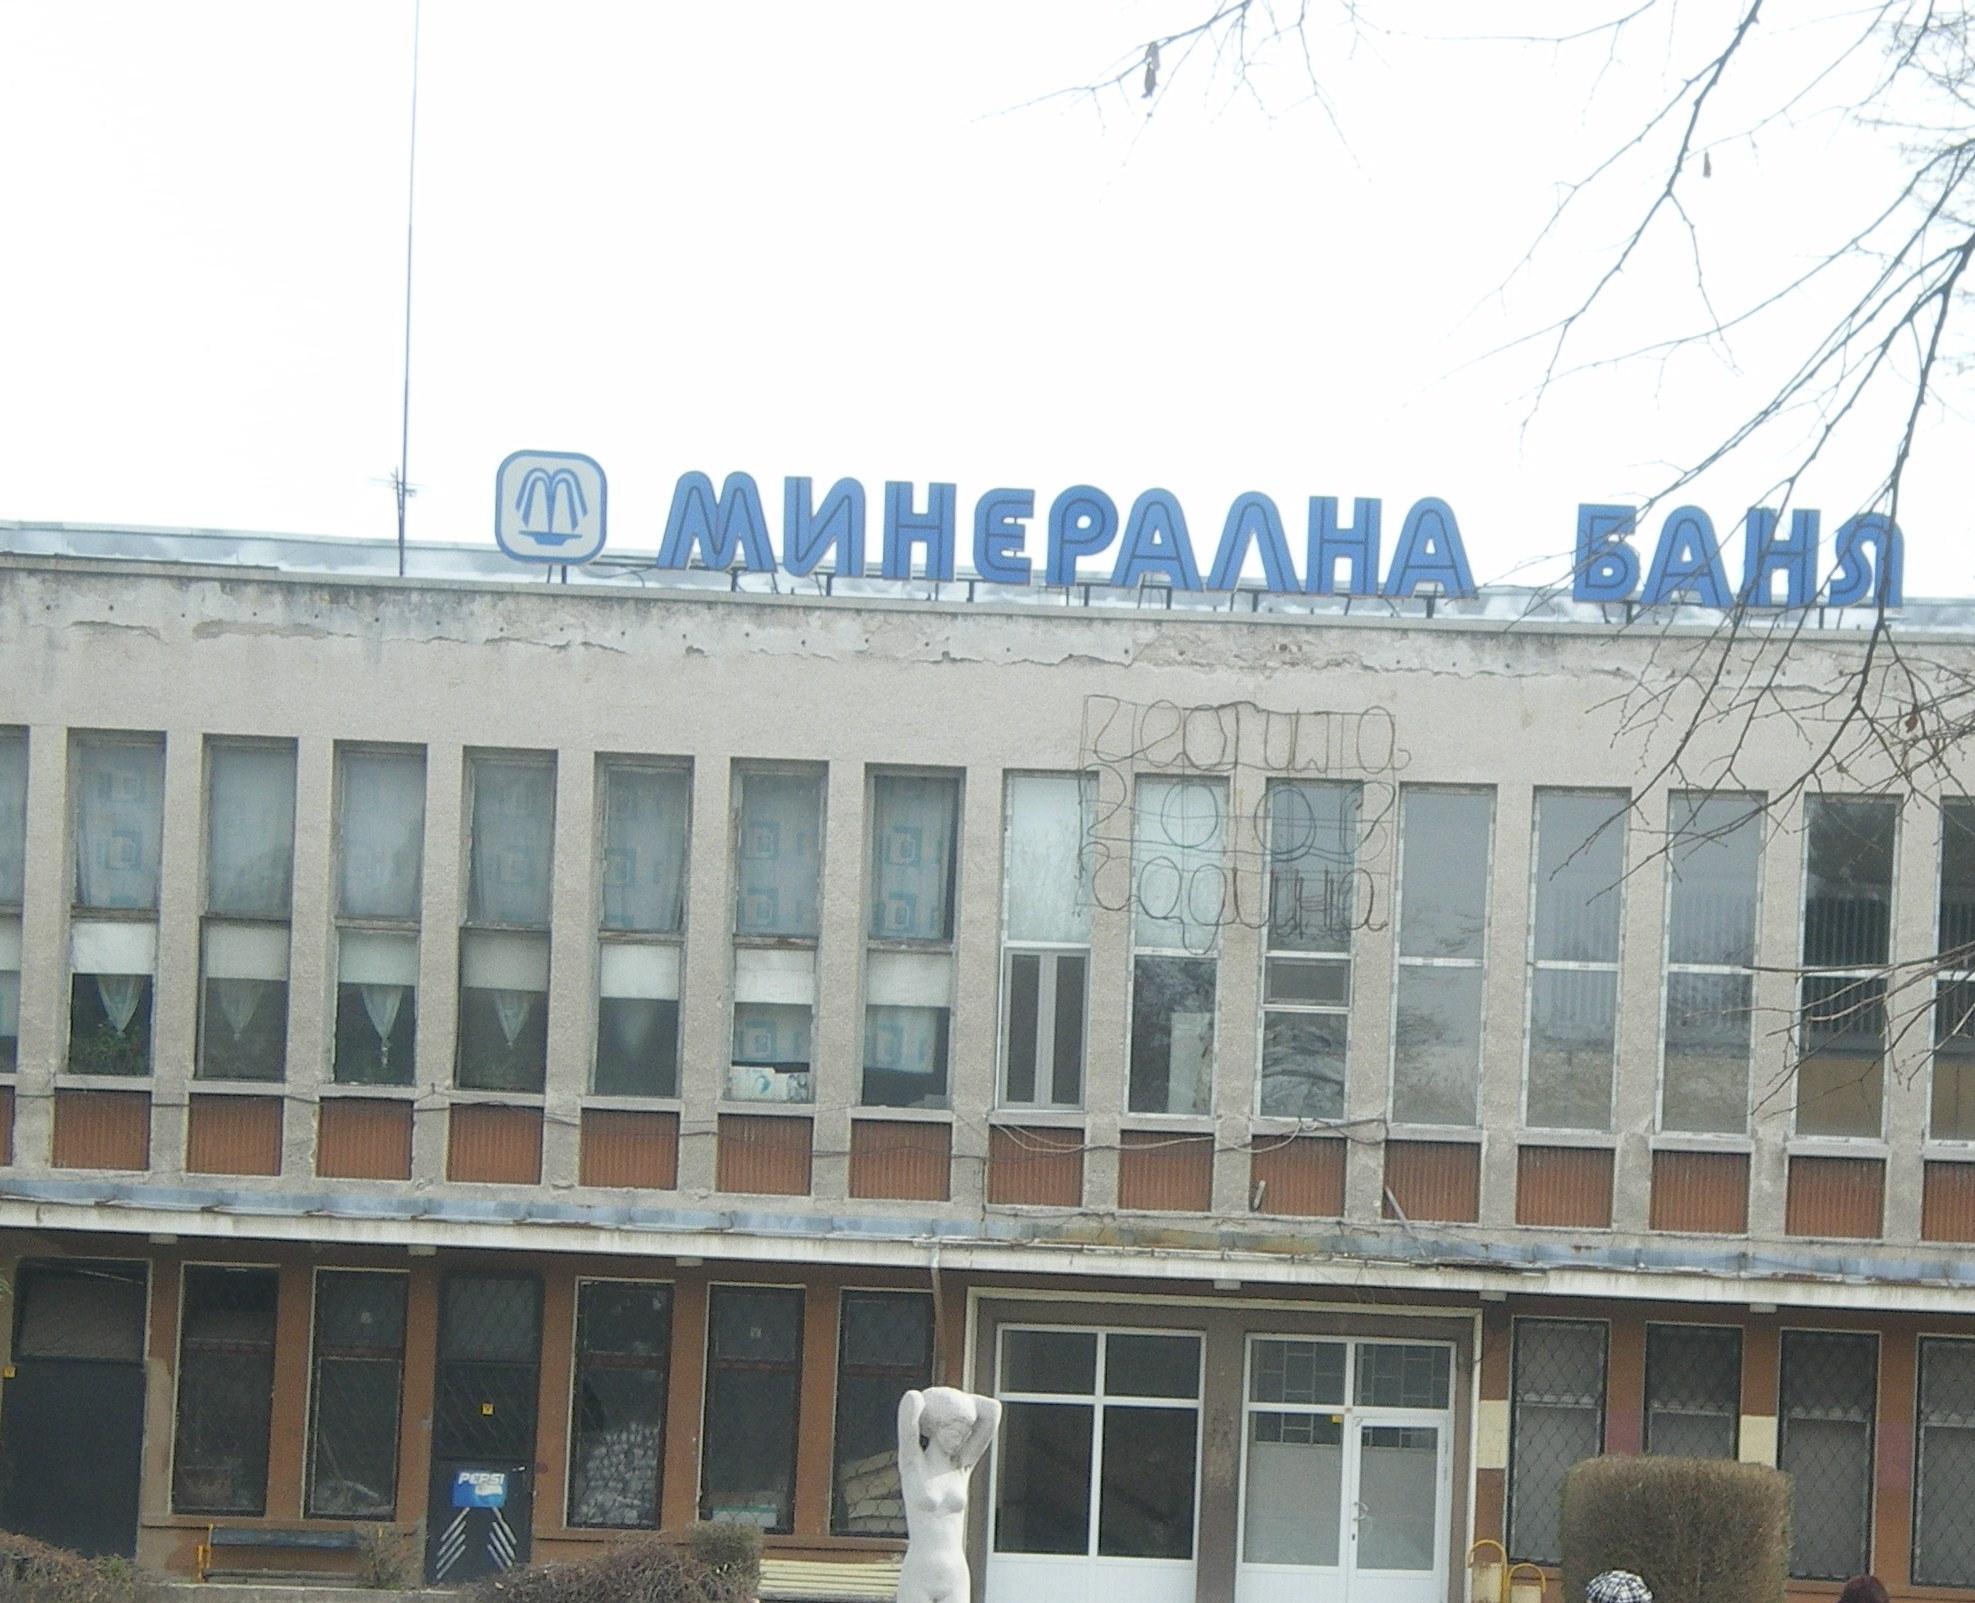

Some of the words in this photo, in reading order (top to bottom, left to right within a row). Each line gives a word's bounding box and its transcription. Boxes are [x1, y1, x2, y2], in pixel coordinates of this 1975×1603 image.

[656, 472, 1475, 599] МИНЕРАЛНА
[1571, 502, 1904, 609] БАНЯ
[458, 1472, 505, 1485] PEPSI
